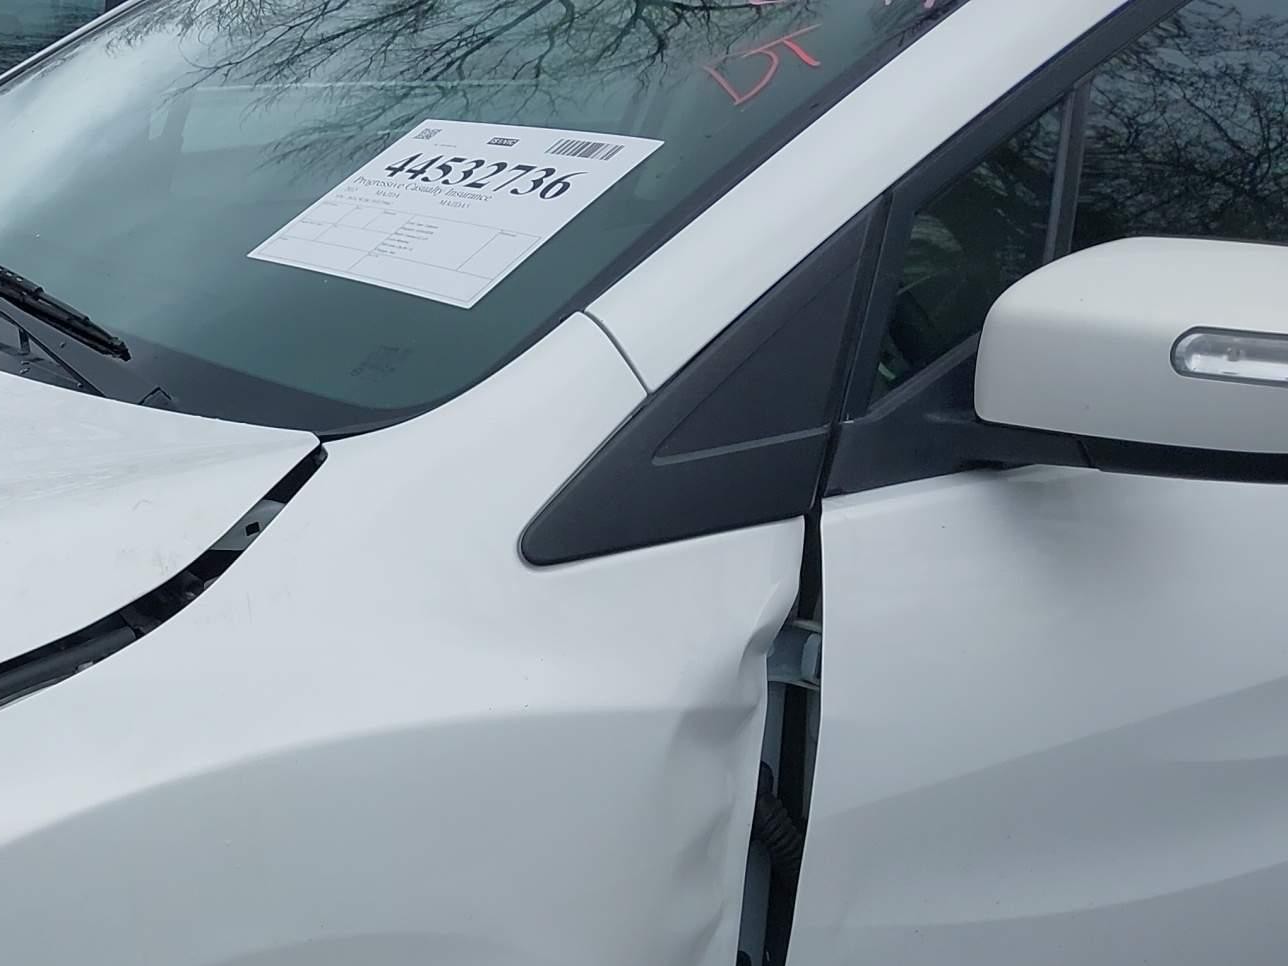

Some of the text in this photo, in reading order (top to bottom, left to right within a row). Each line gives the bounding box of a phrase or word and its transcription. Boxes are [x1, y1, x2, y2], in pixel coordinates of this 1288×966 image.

[353, 176, 405, 190] Progressive
[405, 182, 442, 197] Casualty
[445, 187, 493, 201] Insurance
[385, 153, 588, 200] 44532736
